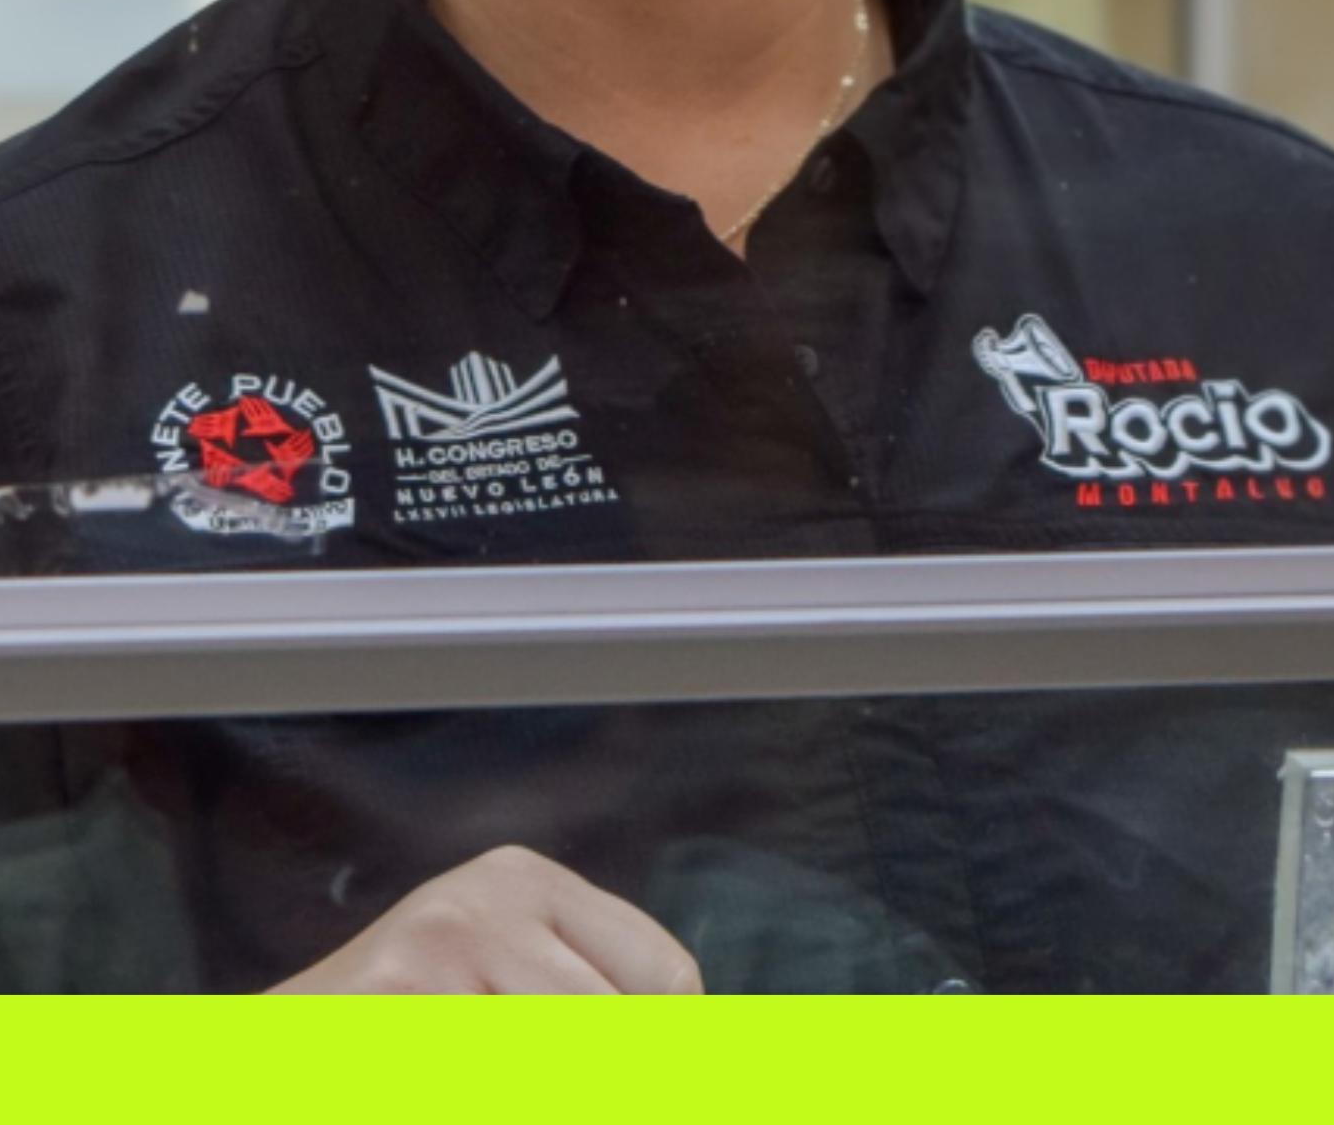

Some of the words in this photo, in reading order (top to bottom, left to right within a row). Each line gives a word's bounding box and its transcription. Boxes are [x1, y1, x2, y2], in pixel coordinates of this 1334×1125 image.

[150, 381, 212, 487] NETE
[229, 373, 353, 494] PUEBLO
[396, 482, 505, 505] NUEVO
[521, 464, 603, 493] LEÓN
[472, 488, 618, 515] LEGISLATURA
[1076, 477, 1325, 507] MONTALVO
